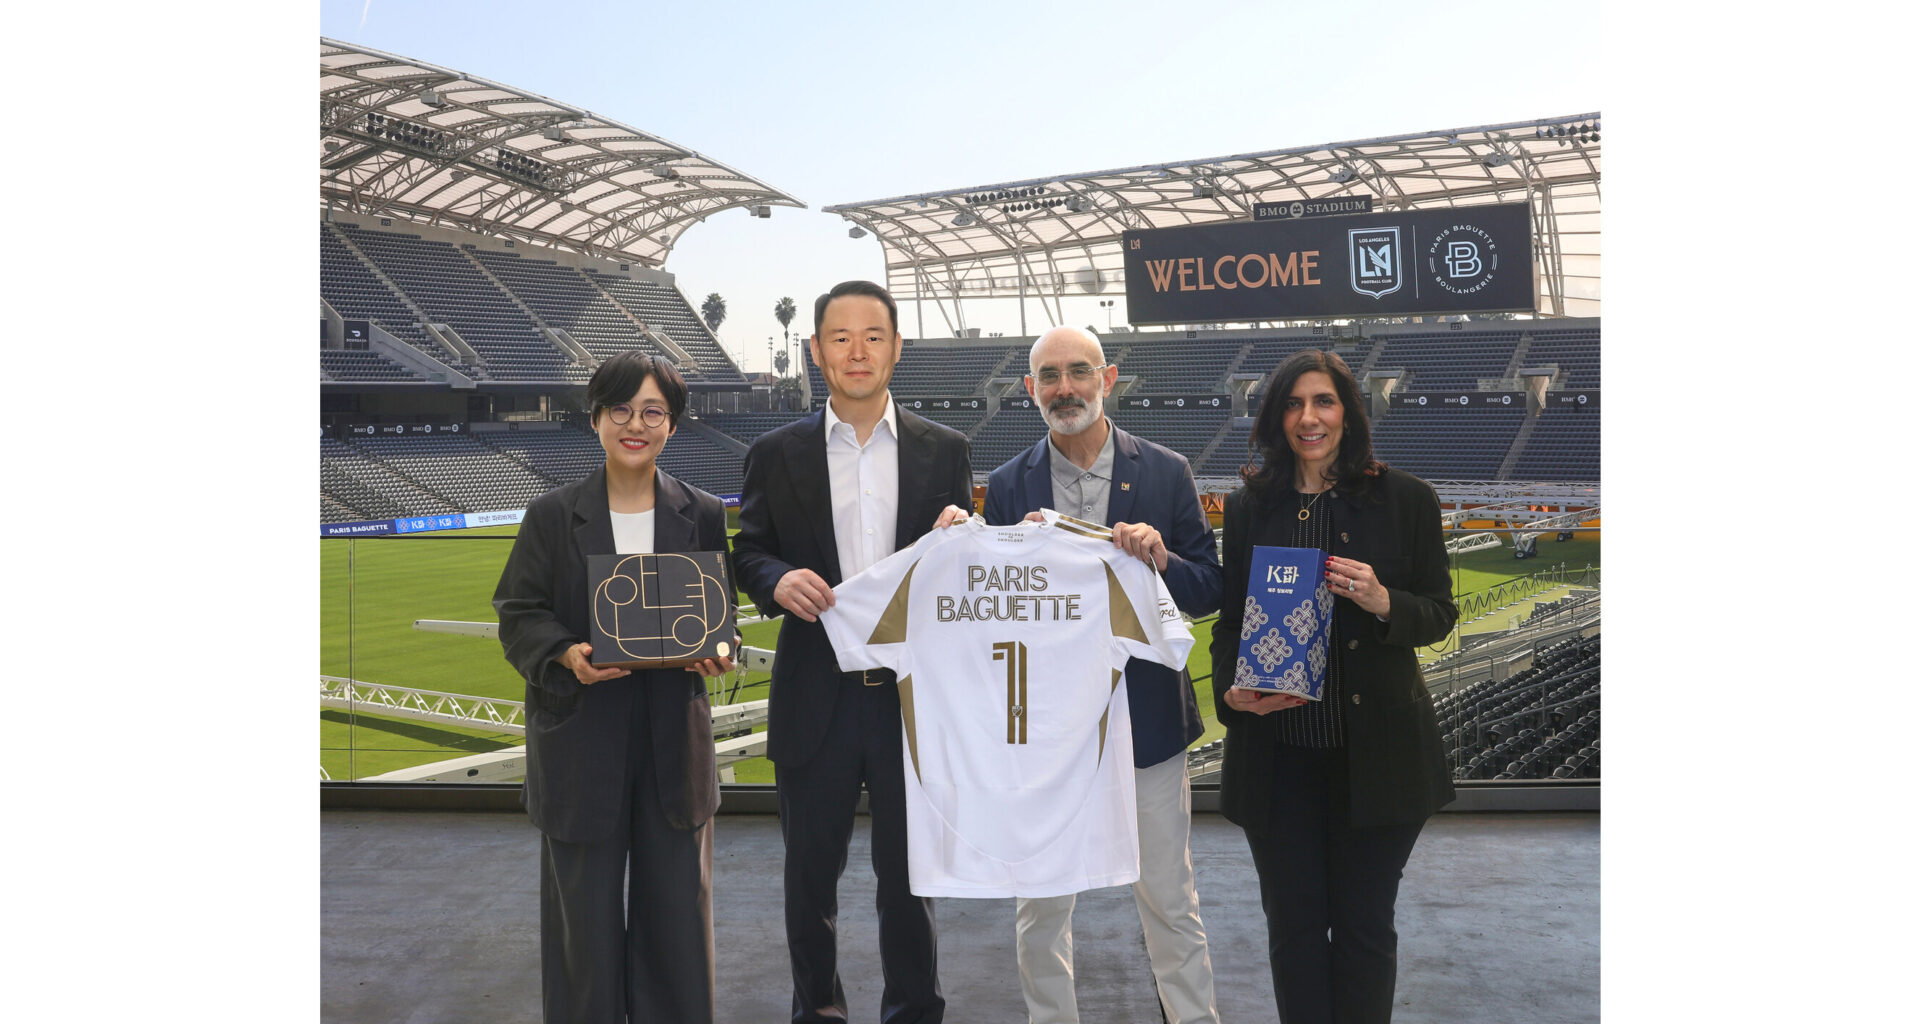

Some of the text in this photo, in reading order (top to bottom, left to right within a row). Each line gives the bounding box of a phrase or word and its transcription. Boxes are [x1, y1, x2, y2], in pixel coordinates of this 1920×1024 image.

[1260, 200, 1366, 217] BMO STADIUM
[1430, 224, 1495, 254] PARIS BAGUETTE
[1145, 250, 1321, 293] WELCOME
[1435, 273, 1494, 294] BOULANGERIE
[968, 565, 1048, 592] PARIS
[937, 594, 1081, 622] BAGUETTE
[993, 640, 1027, 744] 1
